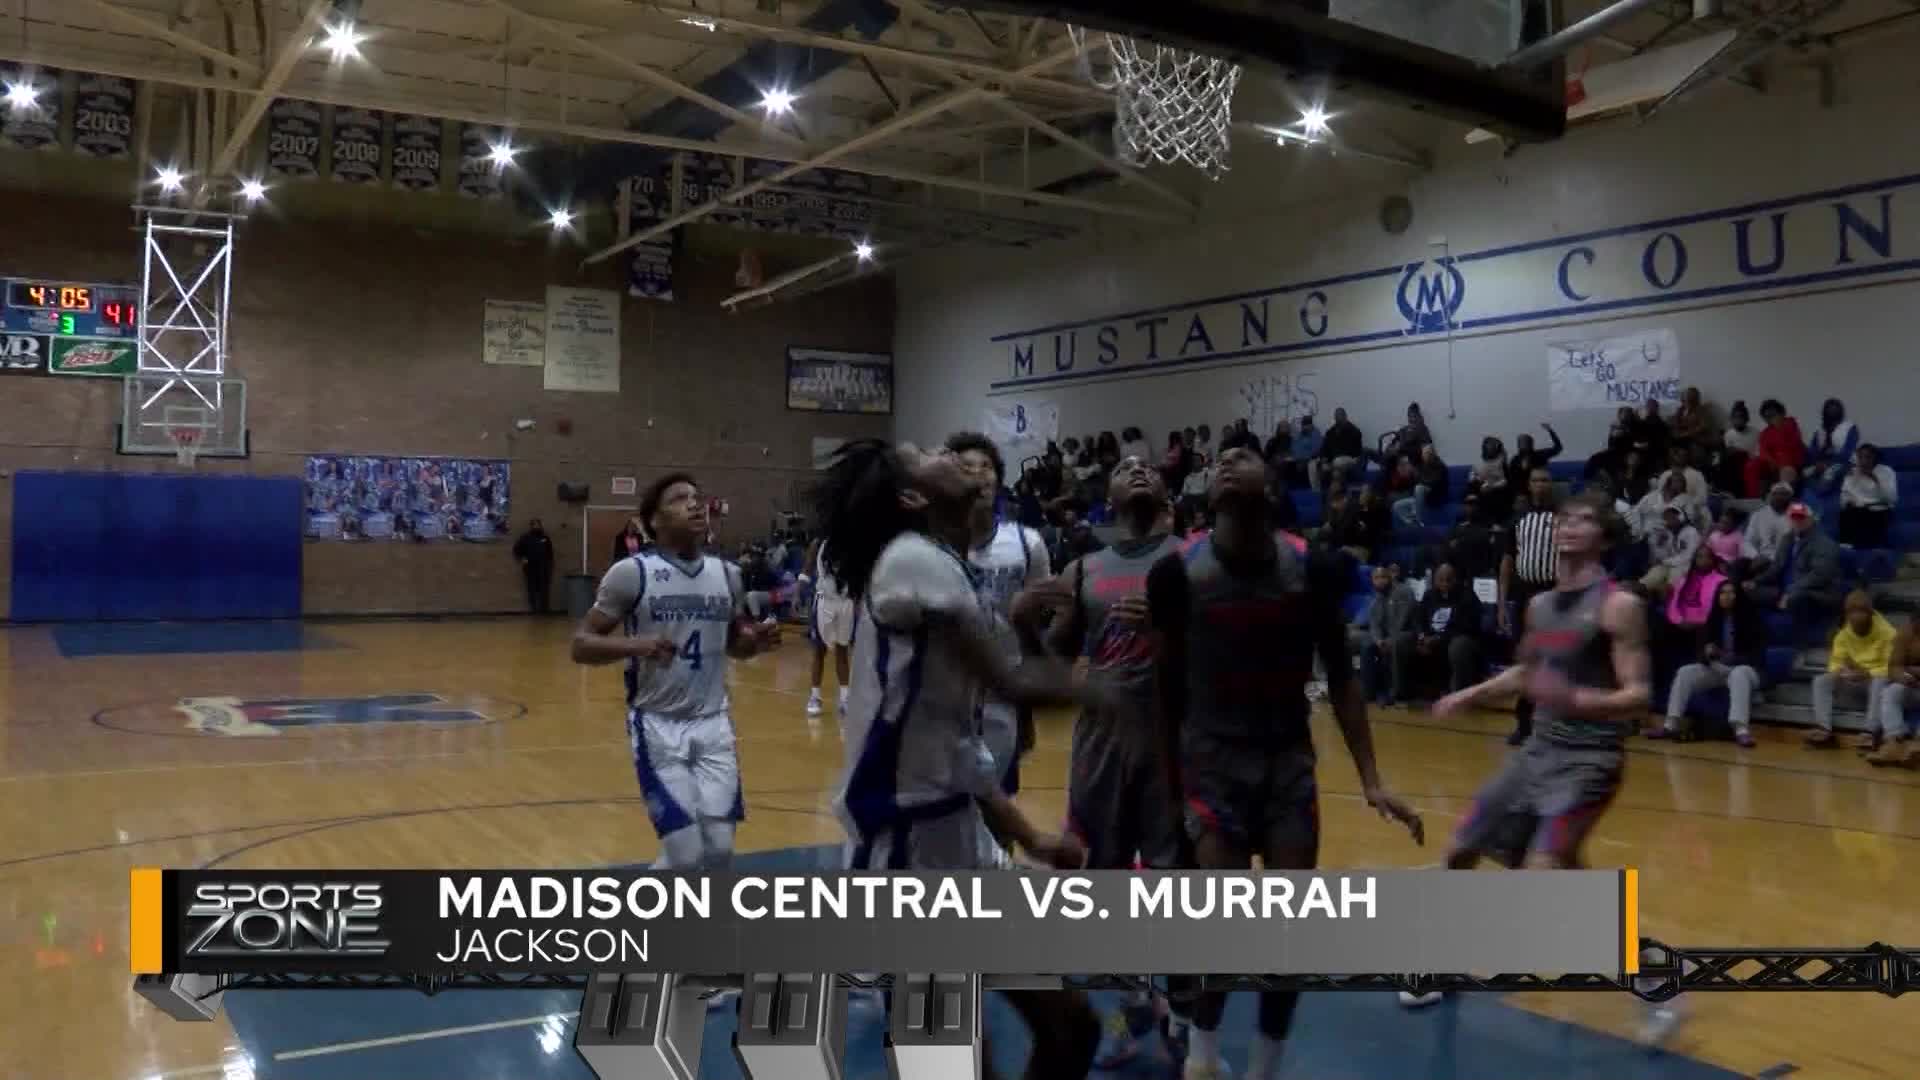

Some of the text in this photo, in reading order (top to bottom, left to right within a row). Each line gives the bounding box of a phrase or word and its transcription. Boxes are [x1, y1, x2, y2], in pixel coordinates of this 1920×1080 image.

[75, 109, 131, 135] 2003
[270, 132, 319, 156] 2007
[393, 148, 440, 169] 2009
[29, 286, 91, 310] 4:05
[61, 316, 75, 335] 3
[104, 303, 136, 327] 41
[1013, 291, 1330, 378] MUSTANG
[679, 629, 702, 671] 4
